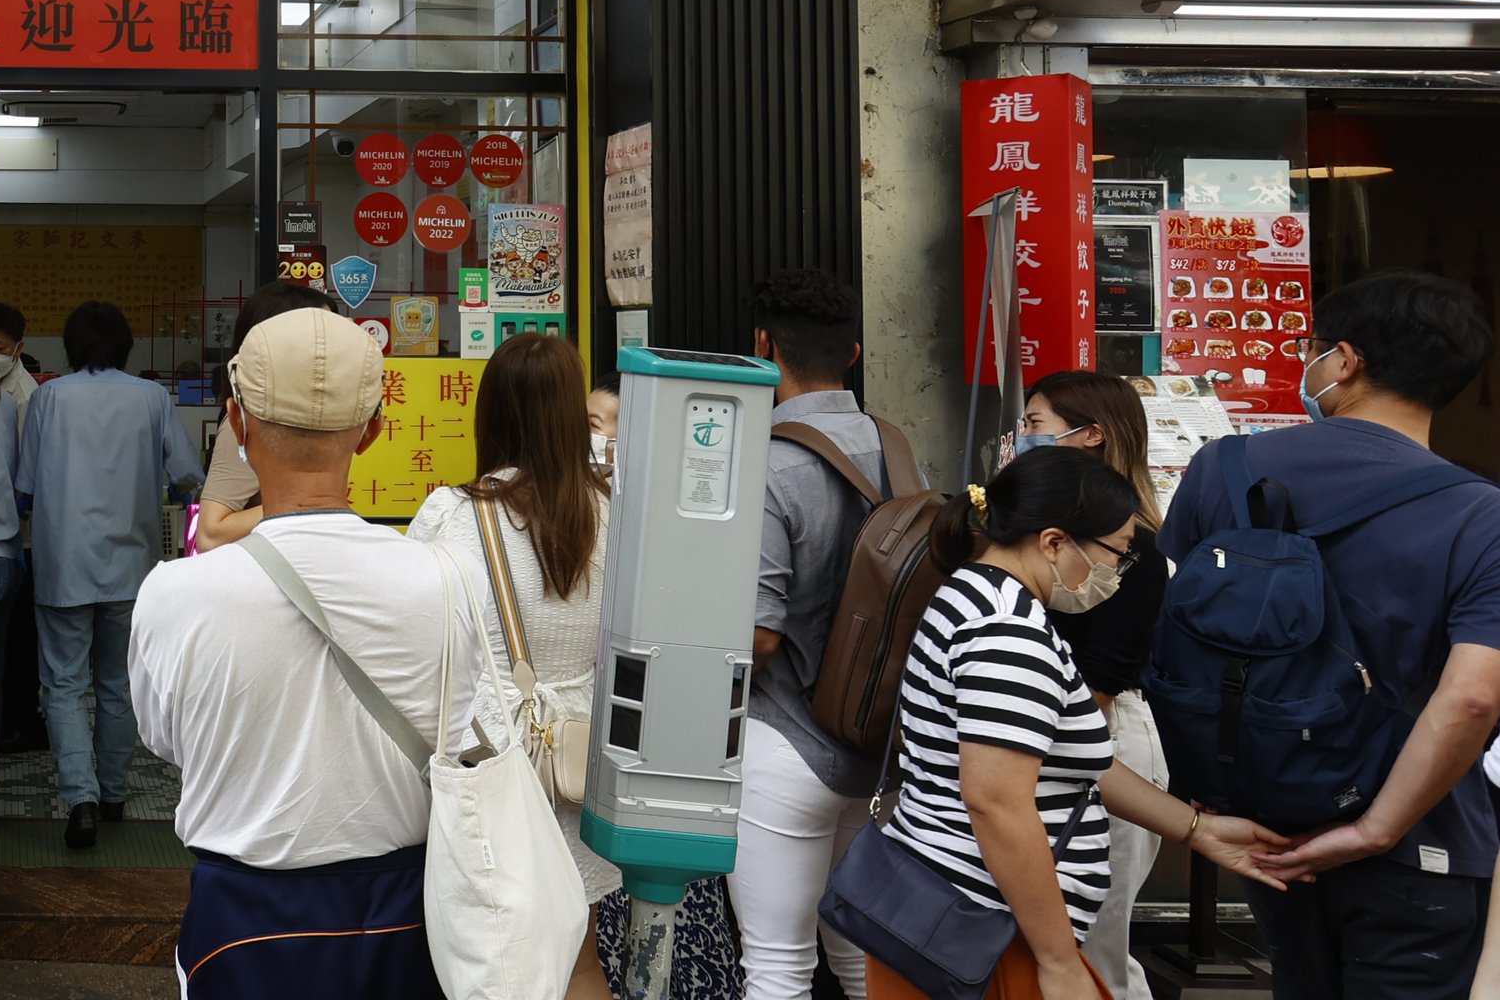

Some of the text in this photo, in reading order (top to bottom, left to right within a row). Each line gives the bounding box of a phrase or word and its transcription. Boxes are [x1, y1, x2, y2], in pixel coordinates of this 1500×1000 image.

[485, 141, 507, 150] 2018
[360, 151, 405, 160] MICHELIN
[417, 149, 462, 158] MICHELIN
[429, 160, 450, 169] 2019
[471, 156, 522, 166] MICHELIN
[372, 163, 392, 171] 2020
[1108, 200, 1140, 208] Dumpling
[358, 210, 404, 219] MICHELIN
[371, 222, 390, 230] 2021
[418, 217, 466, 228] MICHELIN
[429, 229, 453, 239] 2022
[1075, 93, 1090, 368] 龍鳳祥餃子館
[409, 449, 434, 472] 至
